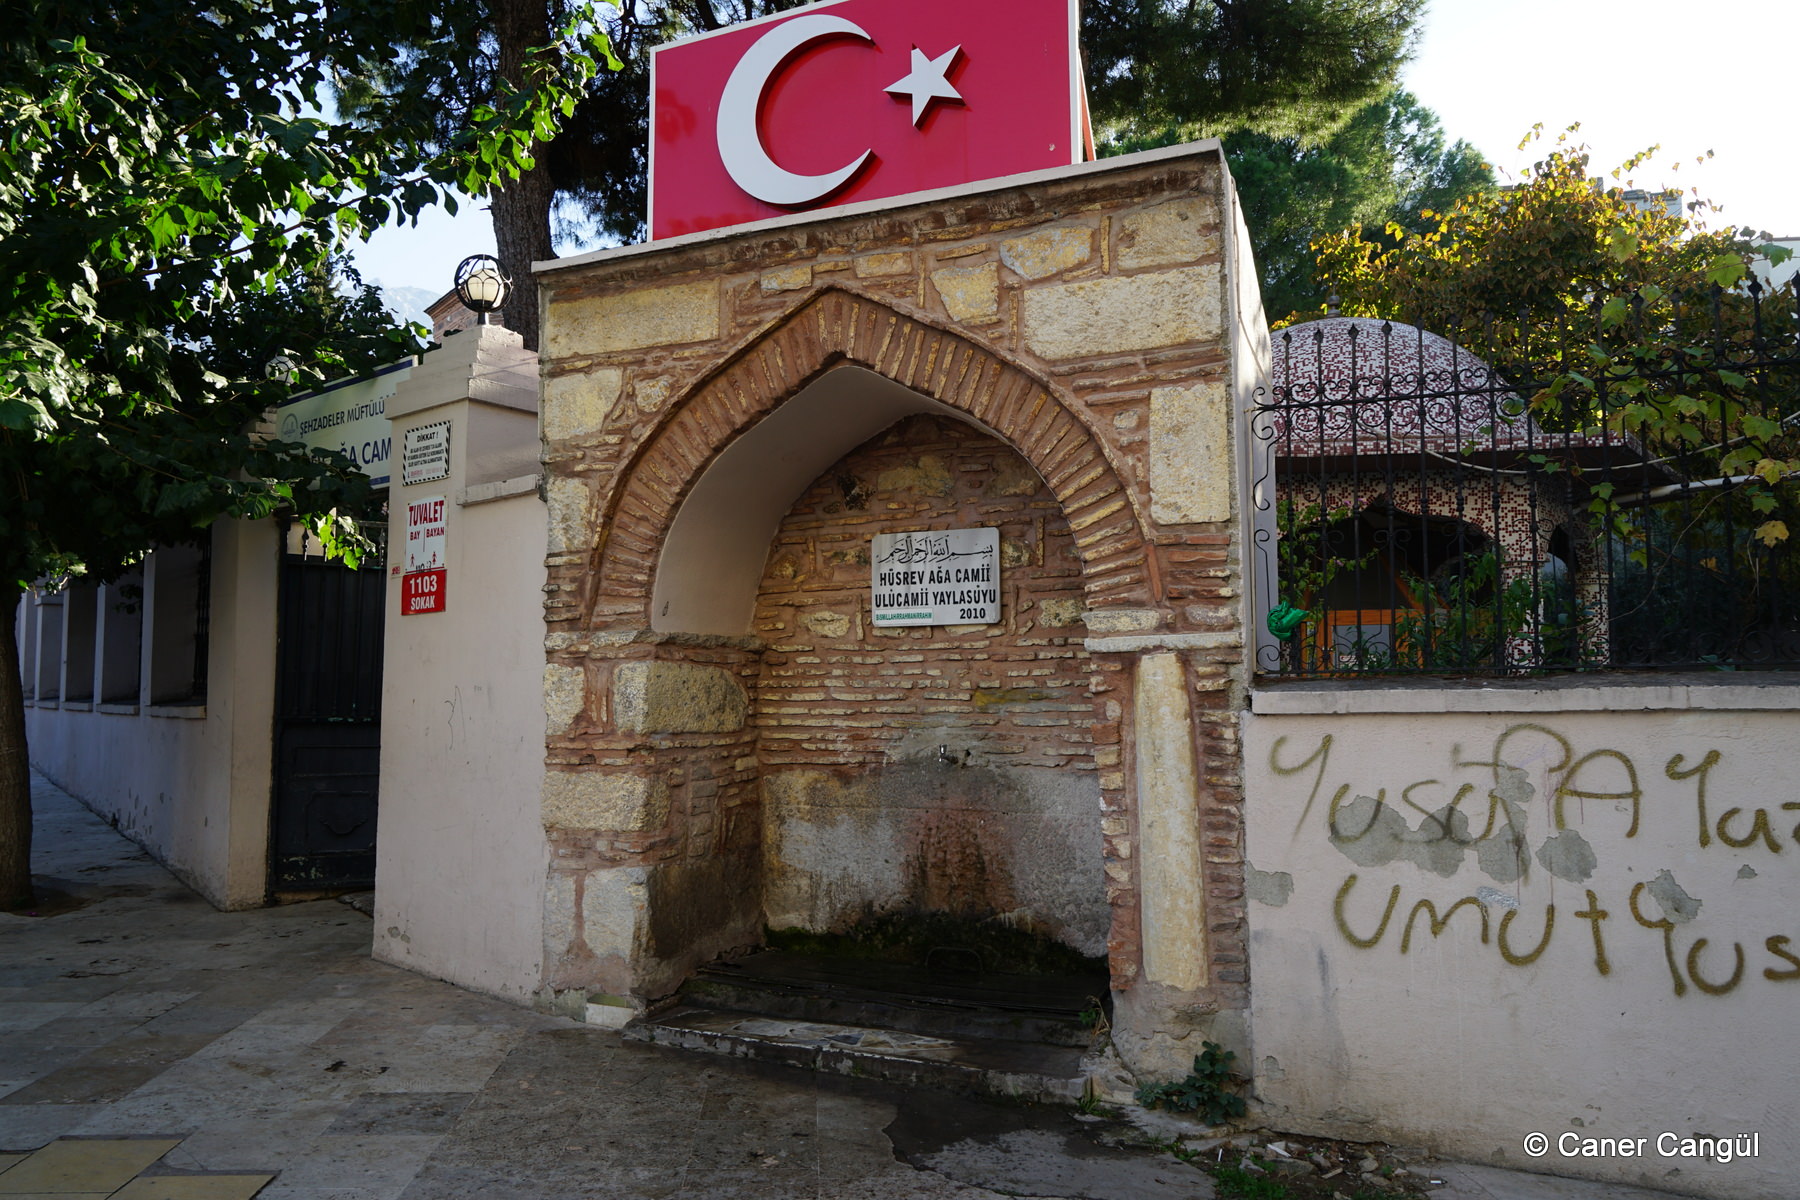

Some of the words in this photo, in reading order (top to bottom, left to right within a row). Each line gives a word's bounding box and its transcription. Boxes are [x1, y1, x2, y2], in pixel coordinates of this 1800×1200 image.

[300, 411, 345, 438] ŞEHZADELER
[417, 431, 435, 443] DİKKAT
[409, 500, 445, 527] TUVALET
[410, 530, 421, 541] BAY
[426, 527, 445, 538] BAYAN
[880, 568, 925, 587] HÜSREV
[929, 566, 951, 585] AĞA
[956, 564, 990, 583] CAMİİ
[410, 575, 437, 595] 1103
[410, 595, 435, 611] SOKAK
[932, 587, 996, 605] YAYLASUYU
[959, 607, 986, 620] 2010
